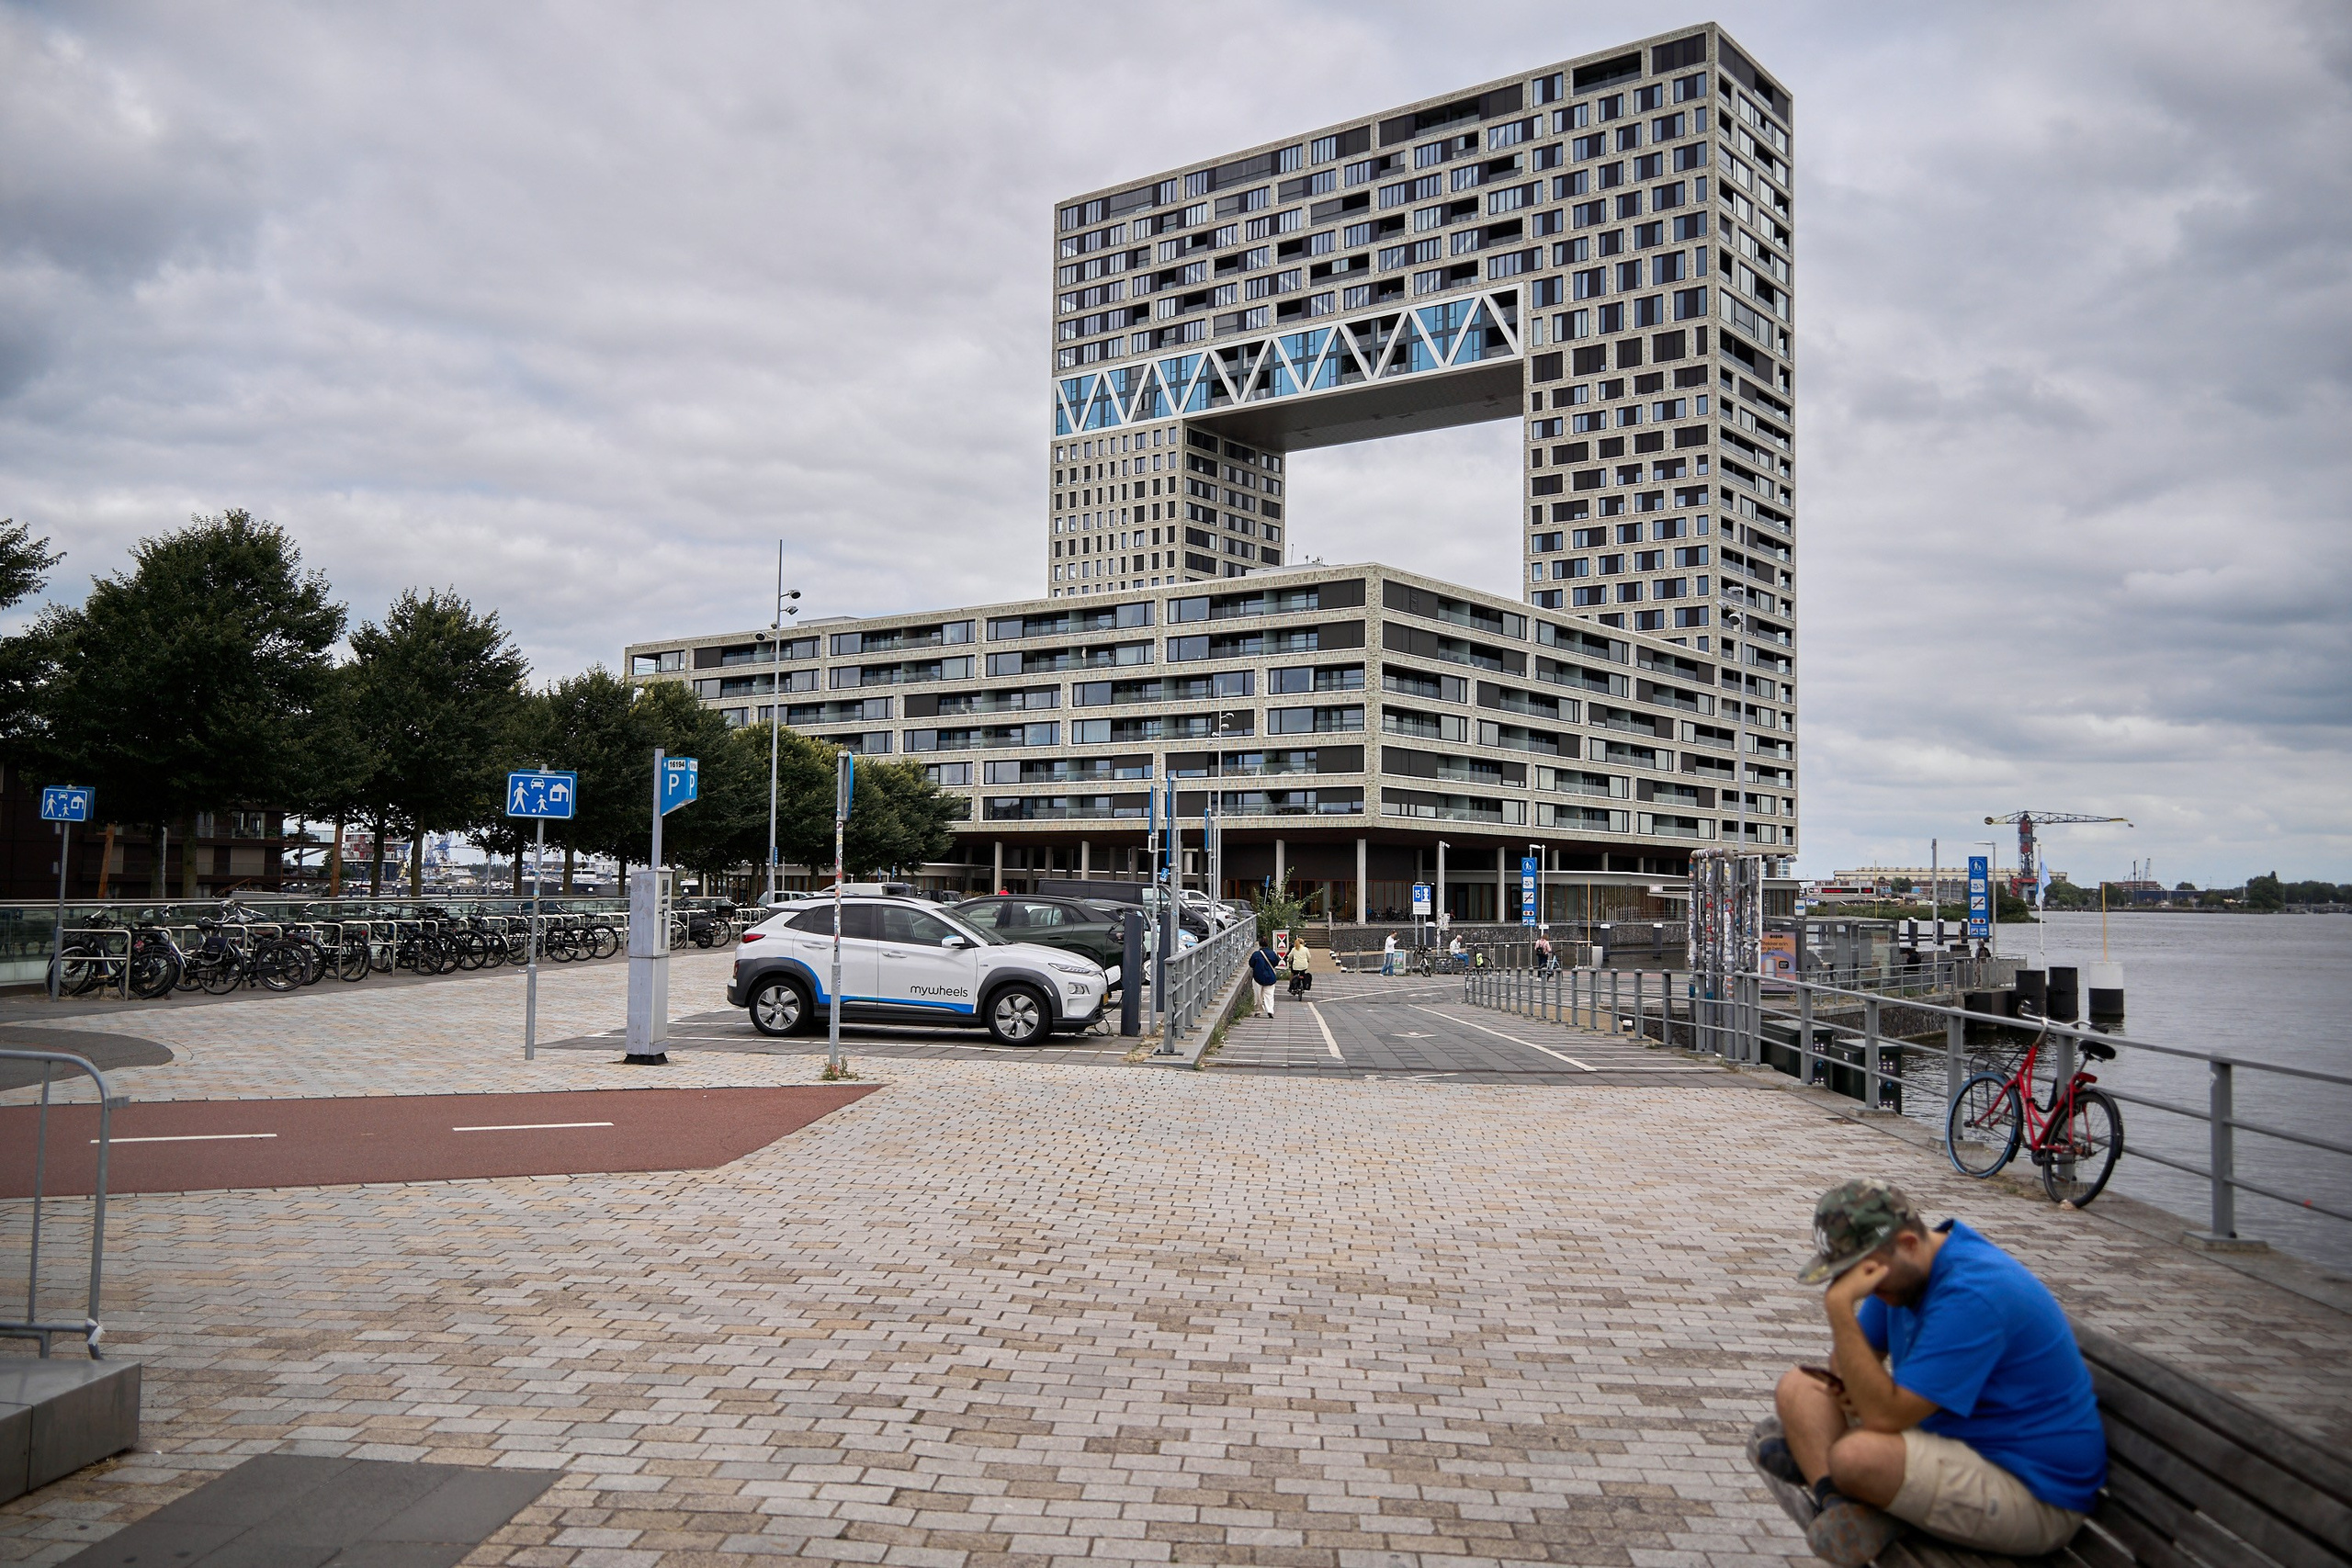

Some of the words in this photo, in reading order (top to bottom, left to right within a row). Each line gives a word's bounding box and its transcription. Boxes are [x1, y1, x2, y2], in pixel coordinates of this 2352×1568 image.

[669, 773, 680, 795] P
[690, 774, 695, 795] P
[1415, 889, 1421, 898] 15
[910, 985, 968, 998] mywheels
